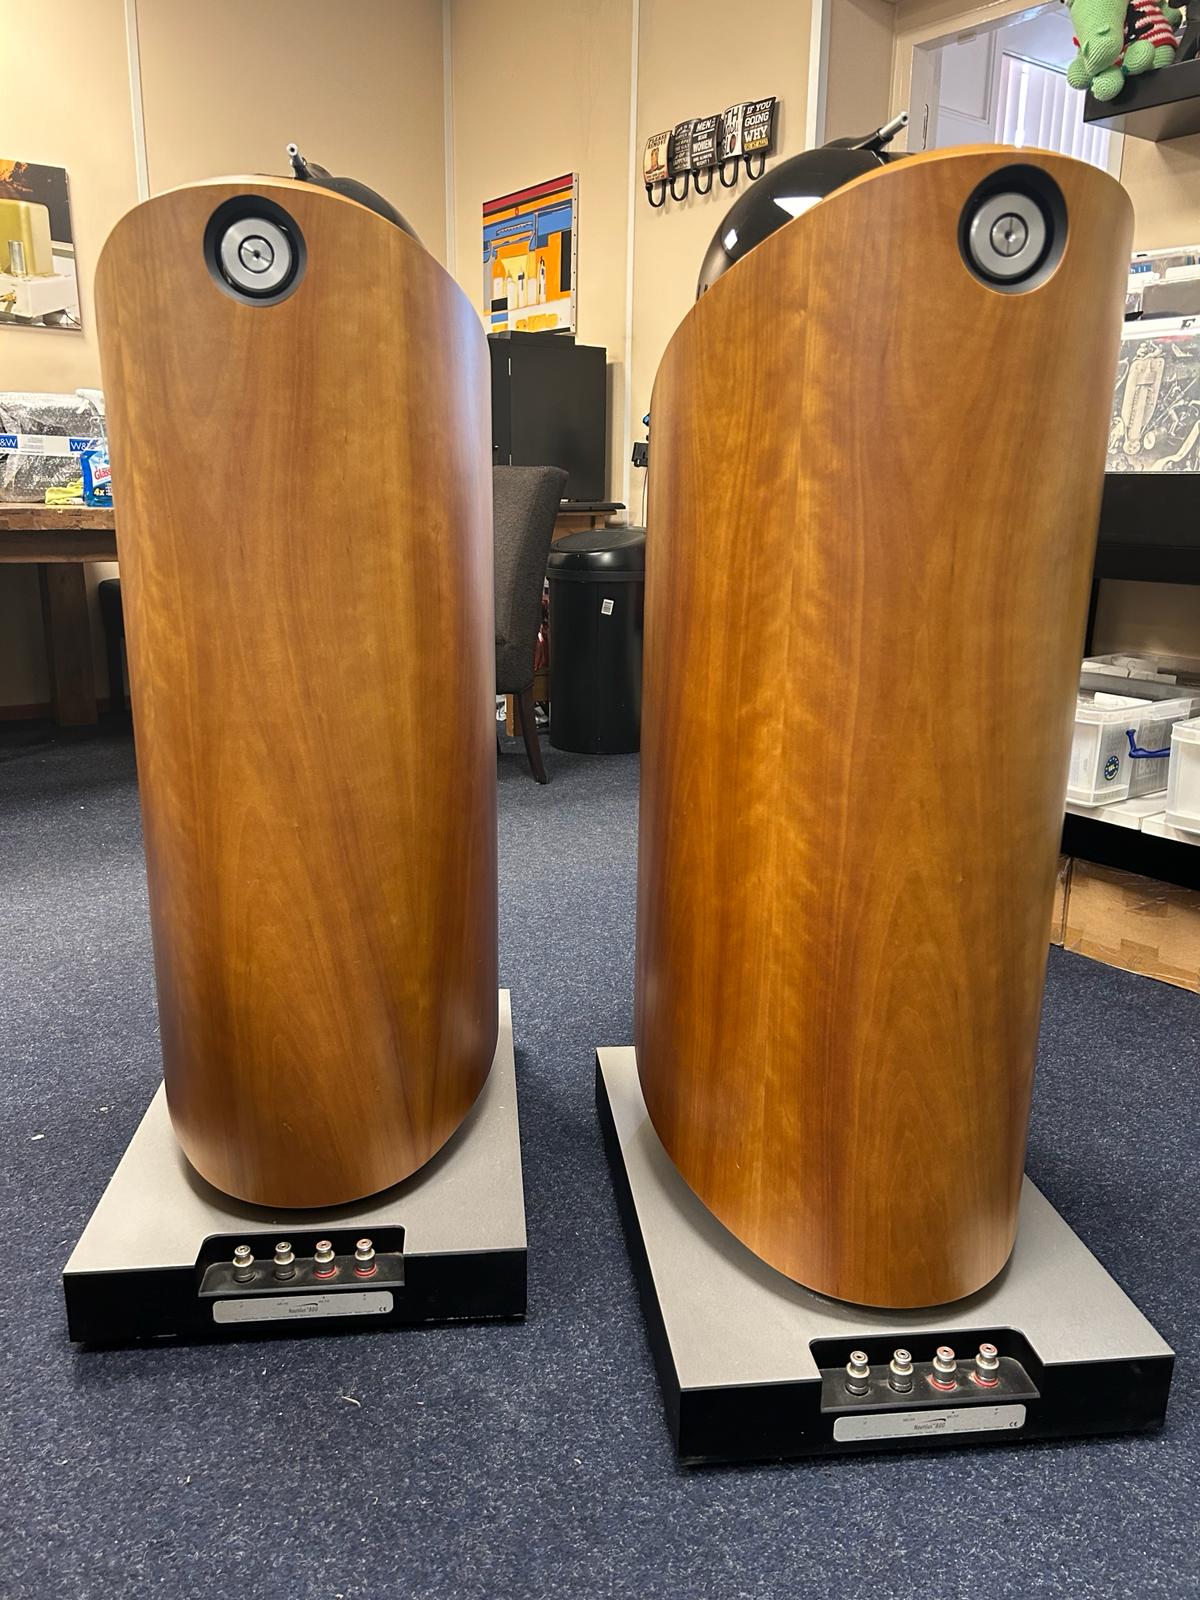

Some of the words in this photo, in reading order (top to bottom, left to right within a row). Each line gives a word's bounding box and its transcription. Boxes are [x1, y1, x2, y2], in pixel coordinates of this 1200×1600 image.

[746, 106, 754, 115] IF
[755, 100, 772, 112] YOU
[696, 119, 712, 133] MEN
[744, 111, 770, 127] GOING
[649, 133, 667, 143] PLEASE
[743, 125, 768, 143] WHY
[692, 138, 713, 153] WOMEN
